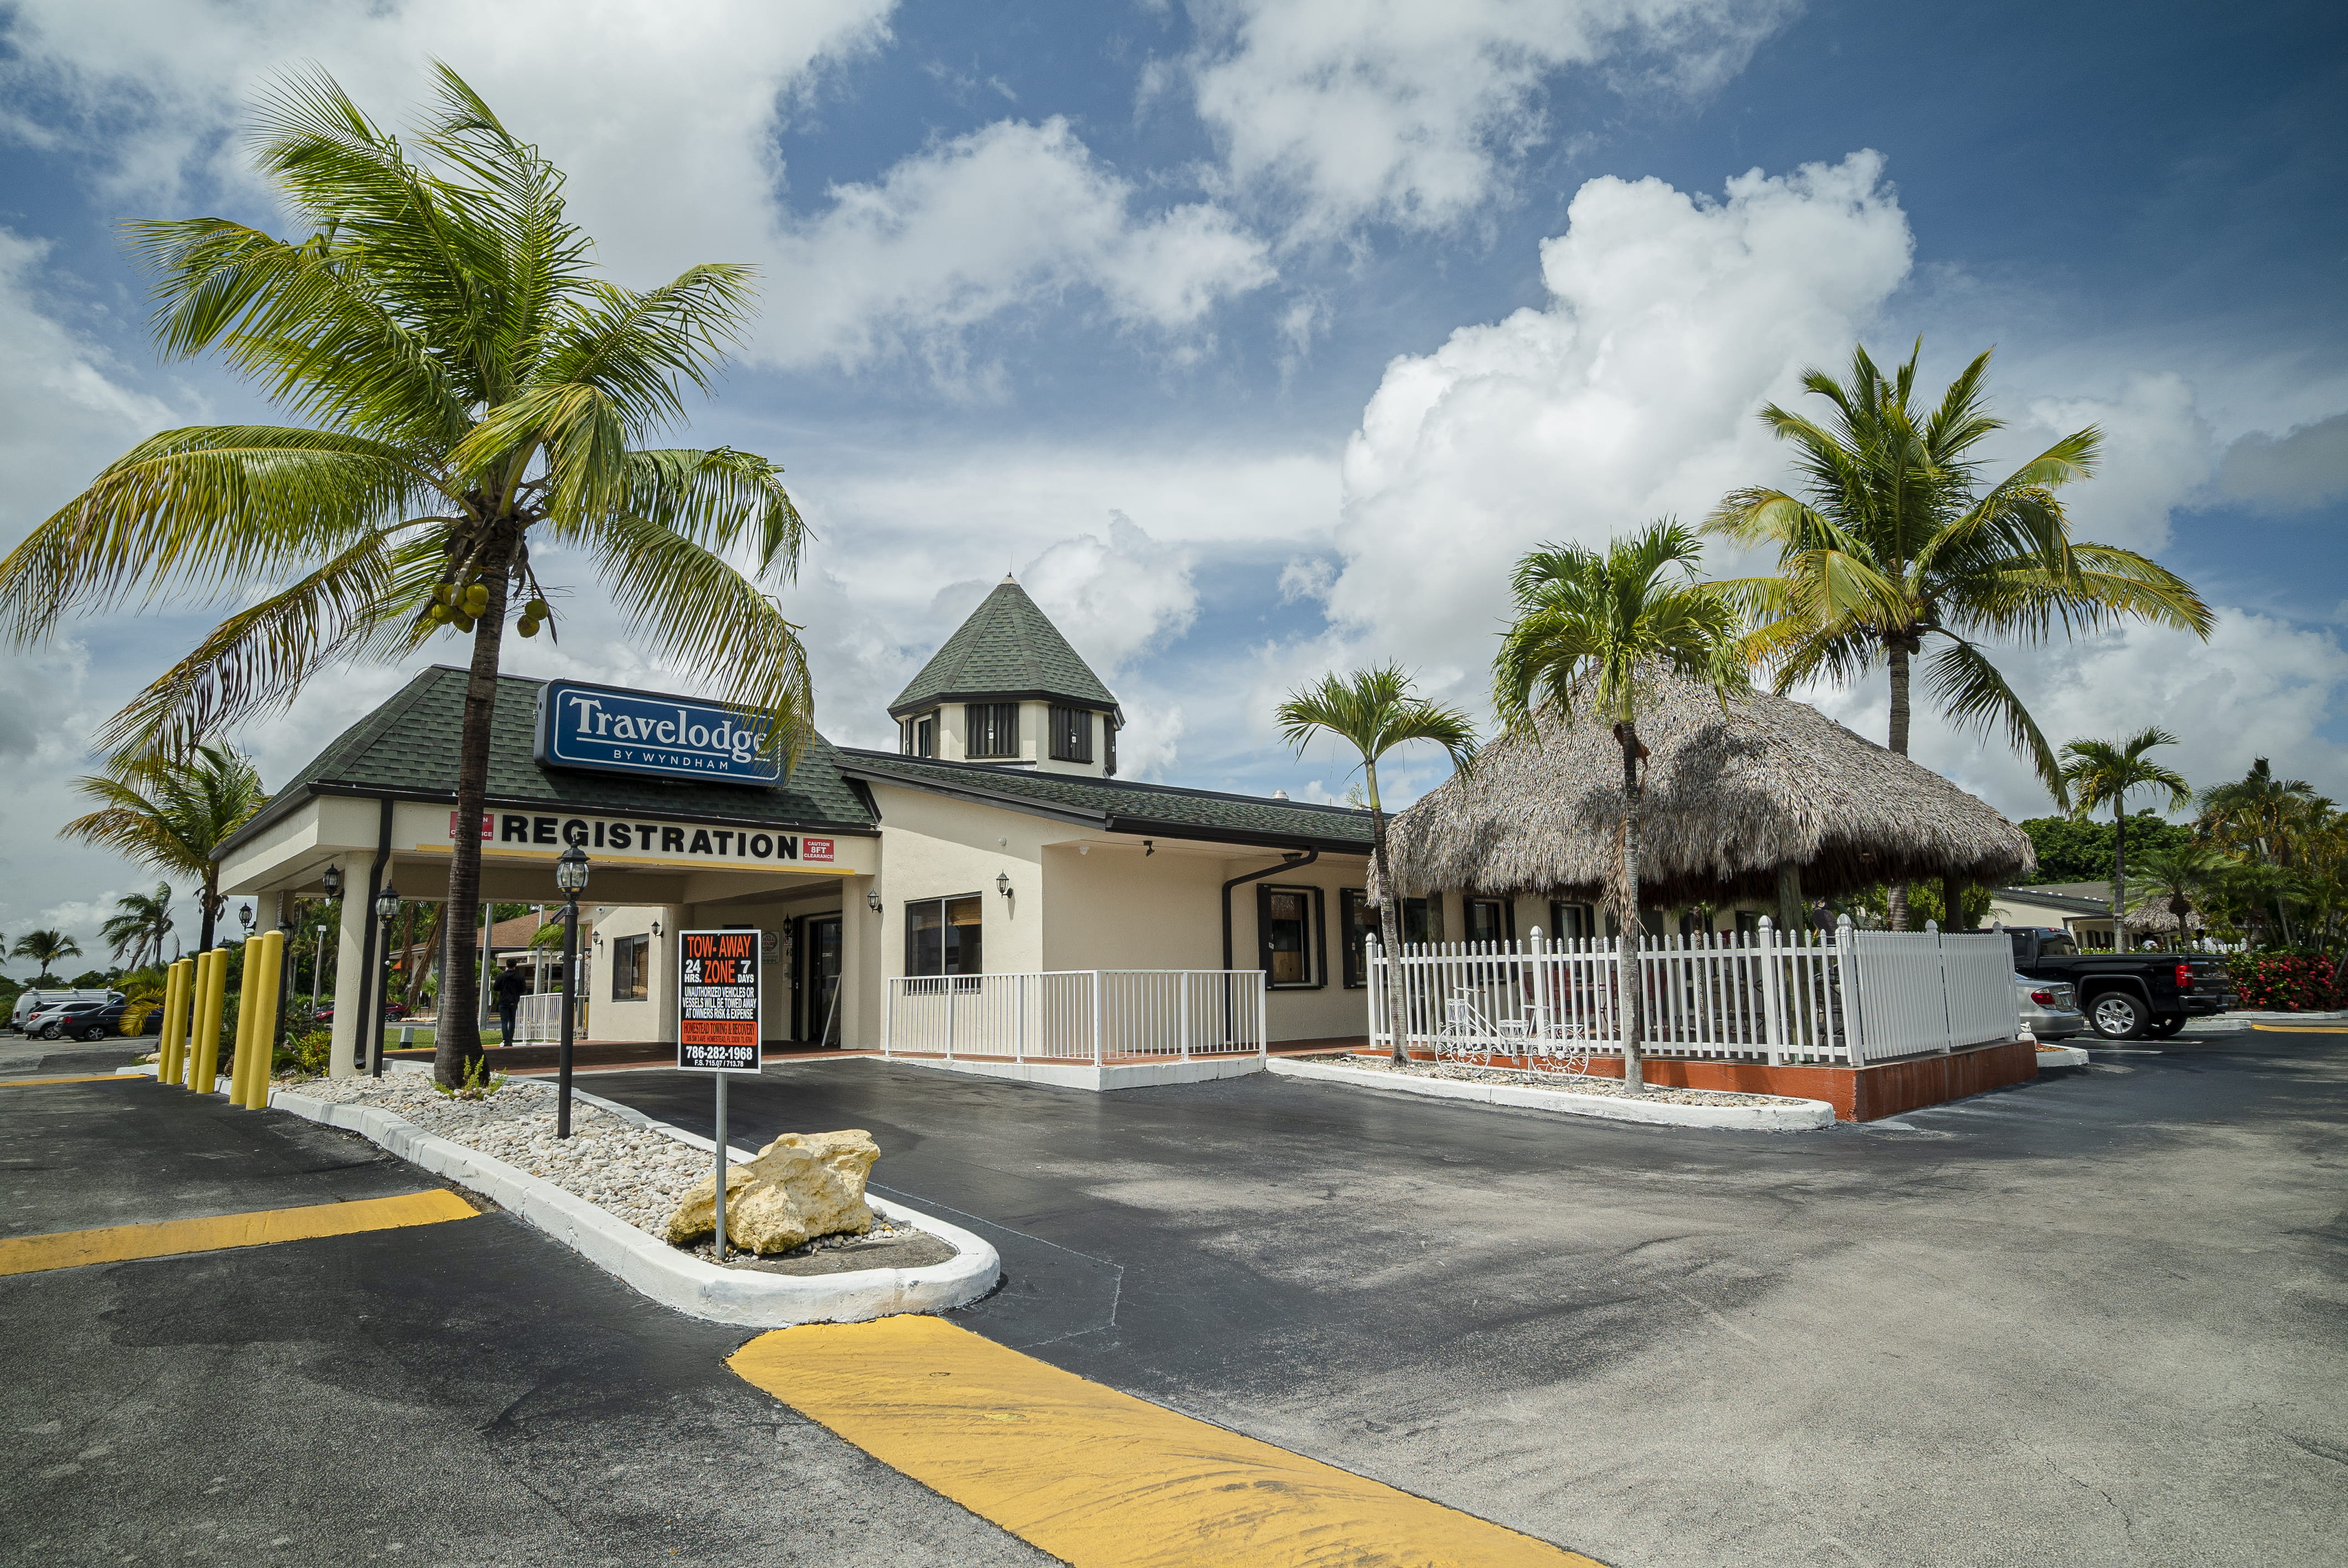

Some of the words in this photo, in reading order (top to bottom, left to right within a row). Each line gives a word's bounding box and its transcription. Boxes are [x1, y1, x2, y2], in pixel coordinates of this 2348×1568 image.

[569, 697, 770, 763] Travelodge
[614, 750, 633, 760] BY
[643, 752, 728, 770] WYNDHAM
[502, 814, 798, 860] REGISTRATION
[718, 936, 751, 957] AWAY
[686, 959, 701, 973] 24
[704, 960, 735, 983] ZONE
[740, 960, 751, 974] 7
[684, 973, 702, 983] HRS.
[738, 974, 754, 983] DAYS
[684, 986, 722, 997] UNAUTHORIZED
[722, 987, 746, 998] VEHICLES
[746, 987, 754, 998] OR
[682, 997, 704, 1008] VESSELS
[704, 998, 717, 1008] WILL
[717, 998, 724, 1008] BE
[724, 998, 742, 1008] TOWED
[743, 998, 756, 1008] AWAY
[685, 1008, 692, 1019] AT
[692, 1008, 713, 1019] OWNERS
[714, 1008, 725, 1019] RISK
[726, 1008, 730, 1019] &
[730, 1008, 754, 1019] EXPENSE
[683, 1022, 709, 1034] HOMESTEAD
[710, 1023, 728, 1034] TOWING
[728, 1023, 732, 1034] &
[733, 1023, 755, 1035] RECOVERY
[686, 1046, 753, 1060] 786-282-1968
